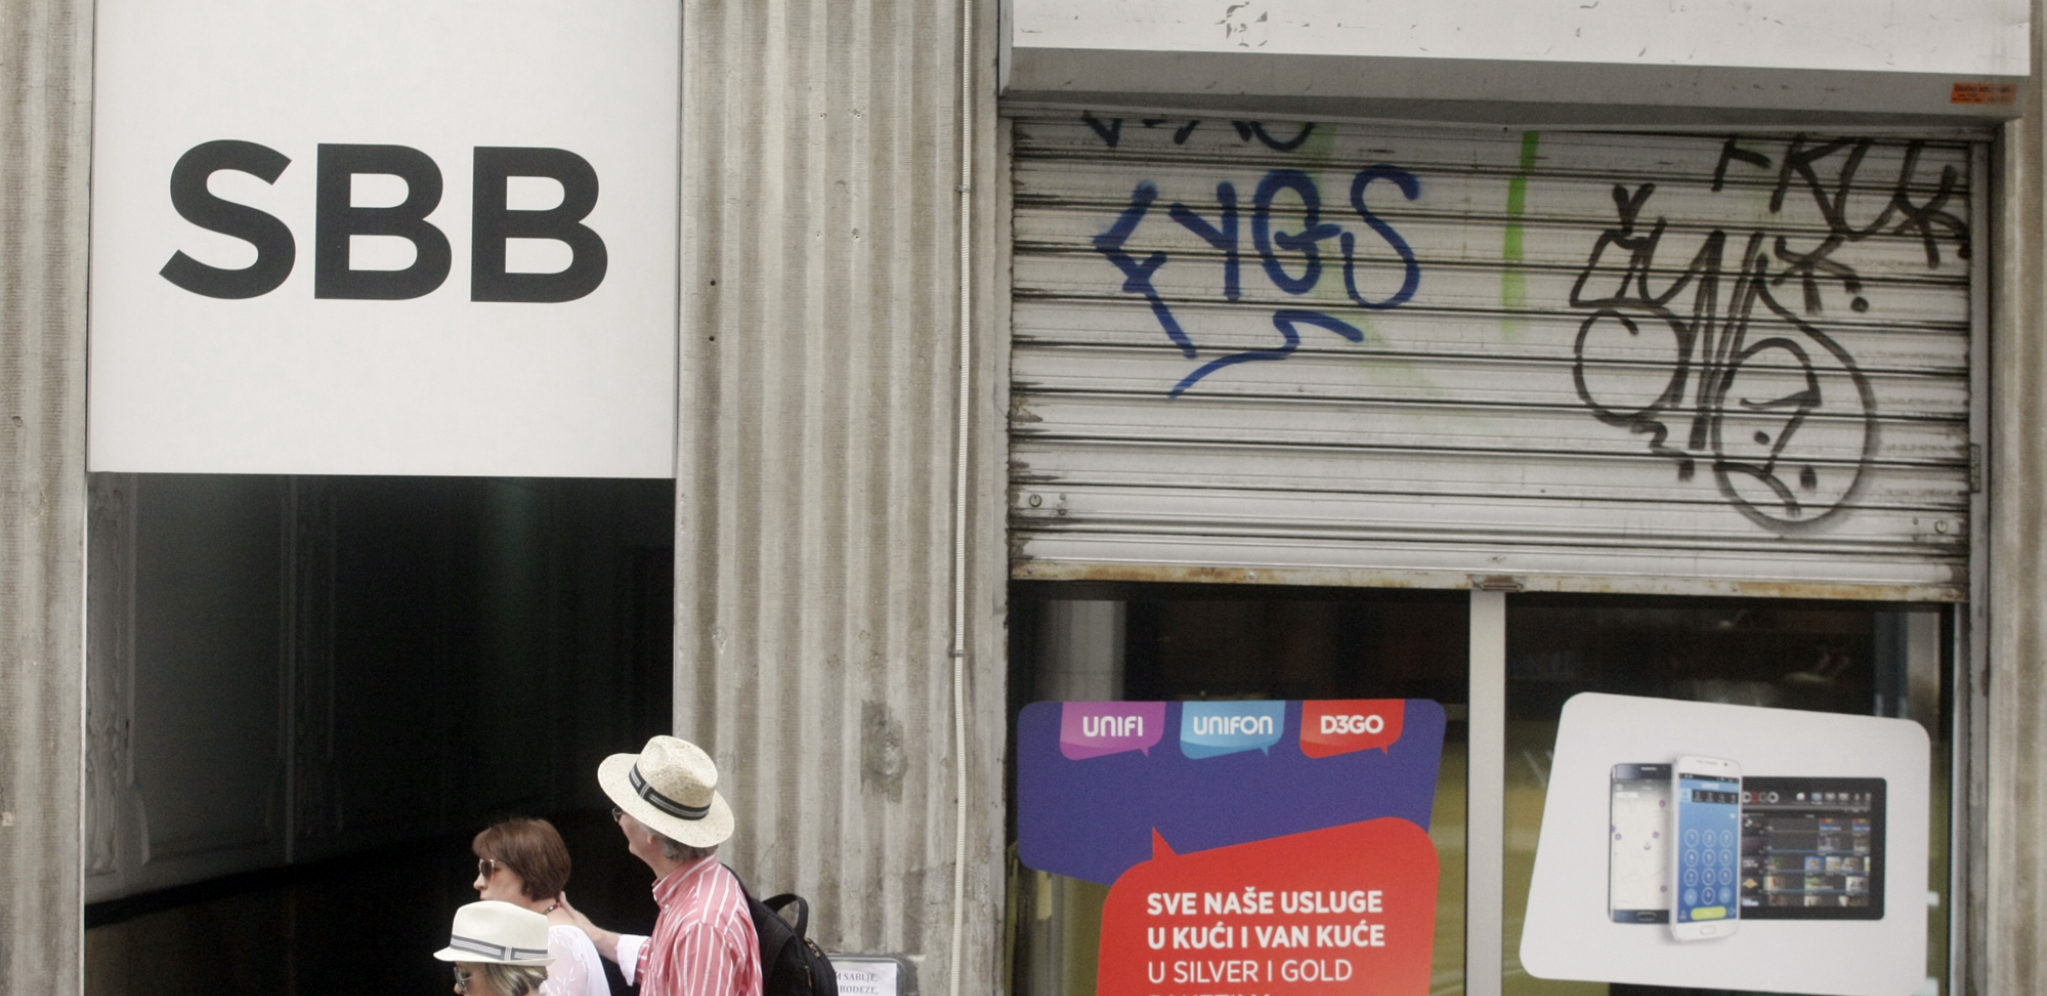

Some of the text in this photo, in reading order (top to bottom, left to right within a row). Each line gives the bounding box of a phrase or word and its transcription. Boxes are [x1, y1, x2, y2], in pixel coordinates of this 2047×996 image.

[159, 139, 608, 304] SBB
[1083, 715, 1144, 737] UNIFI
[1193, 715, 1274, 735] UNIFON
[1320, 714, 1385, 735] D3GO
[1147, 887, 1383, 915] SVE NAŠE USLUGE
[1148, 919, 1386, 950] U KUĆI I VAN KUĆE
[1149, 958, 1353, 984] U SILVER I GOLD
